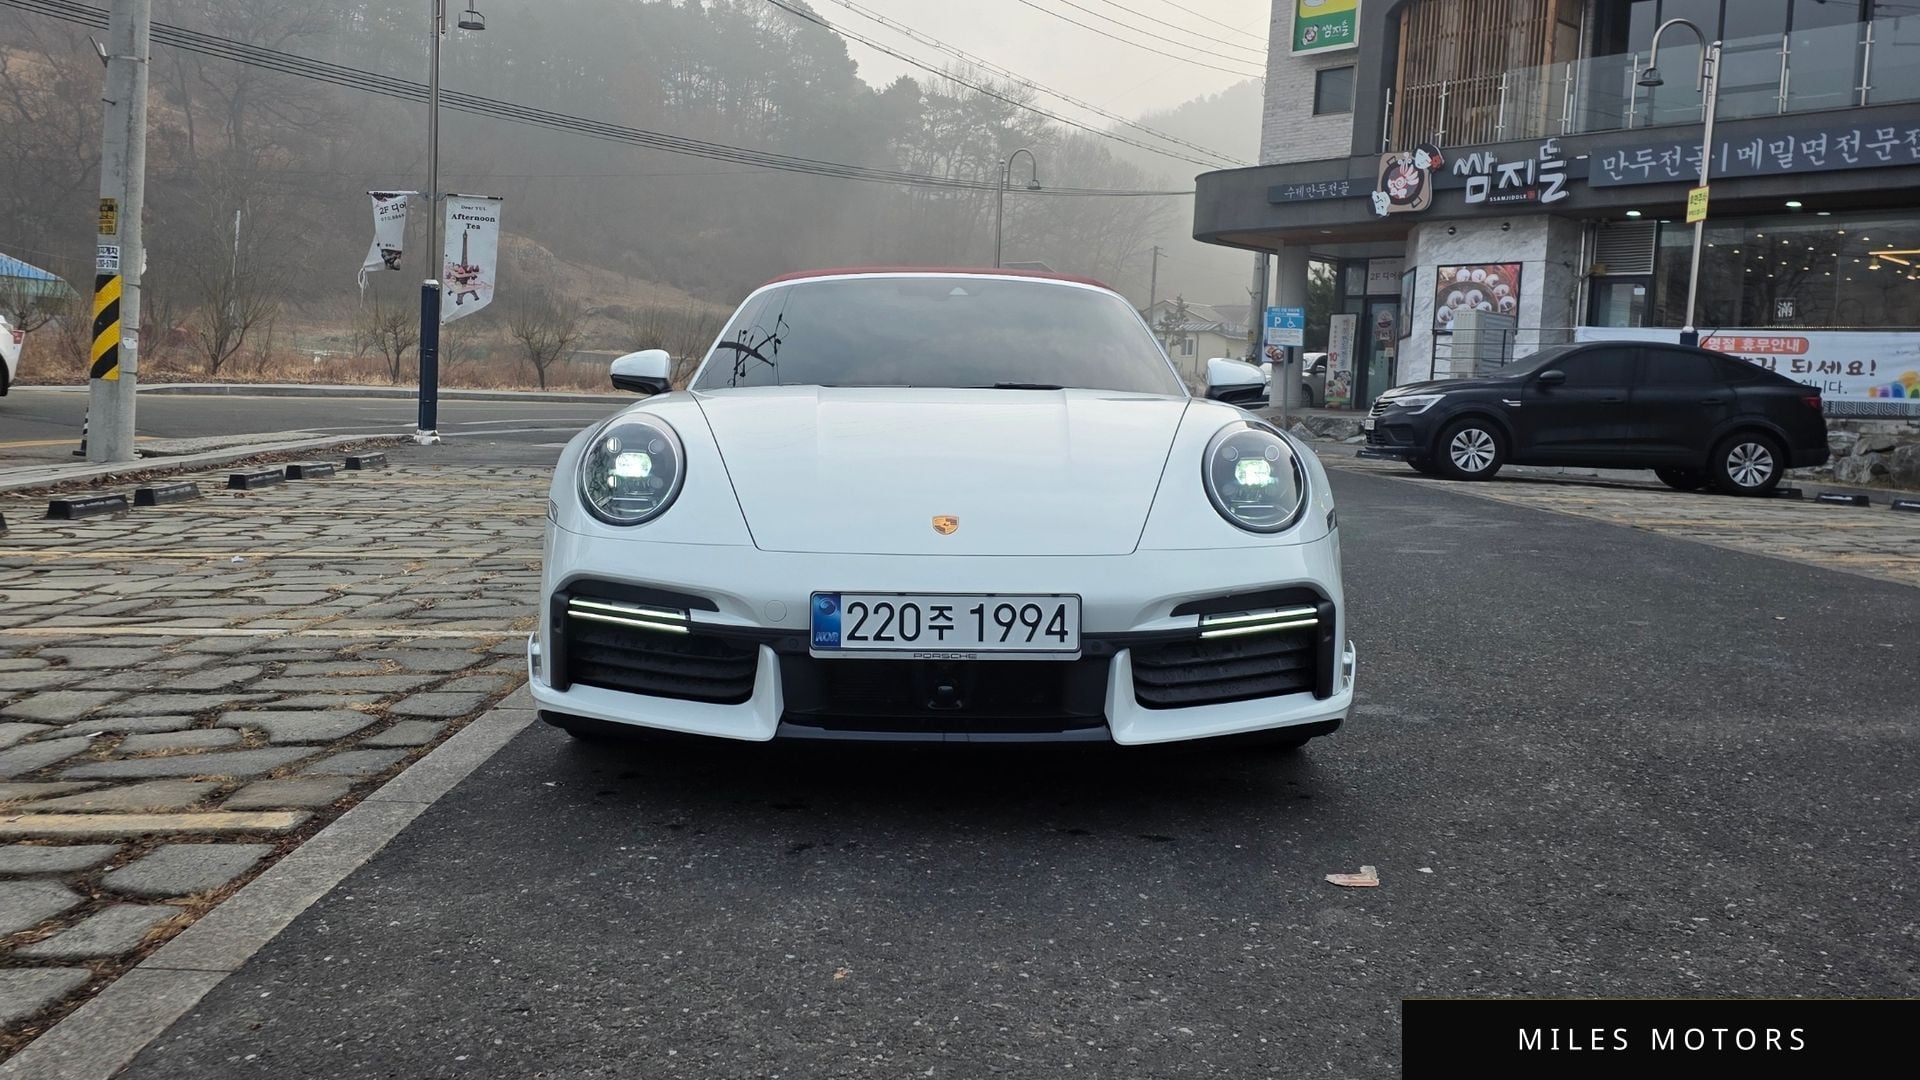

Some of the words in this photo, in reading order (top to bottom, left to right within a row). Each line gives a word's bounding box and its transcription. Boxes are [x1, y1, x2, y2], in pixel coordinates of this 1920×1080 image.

[1322, 20, 1349, 38] 쌈지들
[1737, 127, 1920, 170] 메밀면전문점
[1453, 138, 1570, 204] 쌈지들
[379, 206, 389, 215] 2F
[451, 213, 496, 223] Afternoon
[1274, 316, 1281, 328] P
[1743, 338, 1800, 352] 휴무안내
[1790, 359, 1877, 377] 되세요!
[846, 601, 954, 642] 220주
[969, 603, 1069, 643] 1994
[913, 652, 978, 660] PORSCHE
